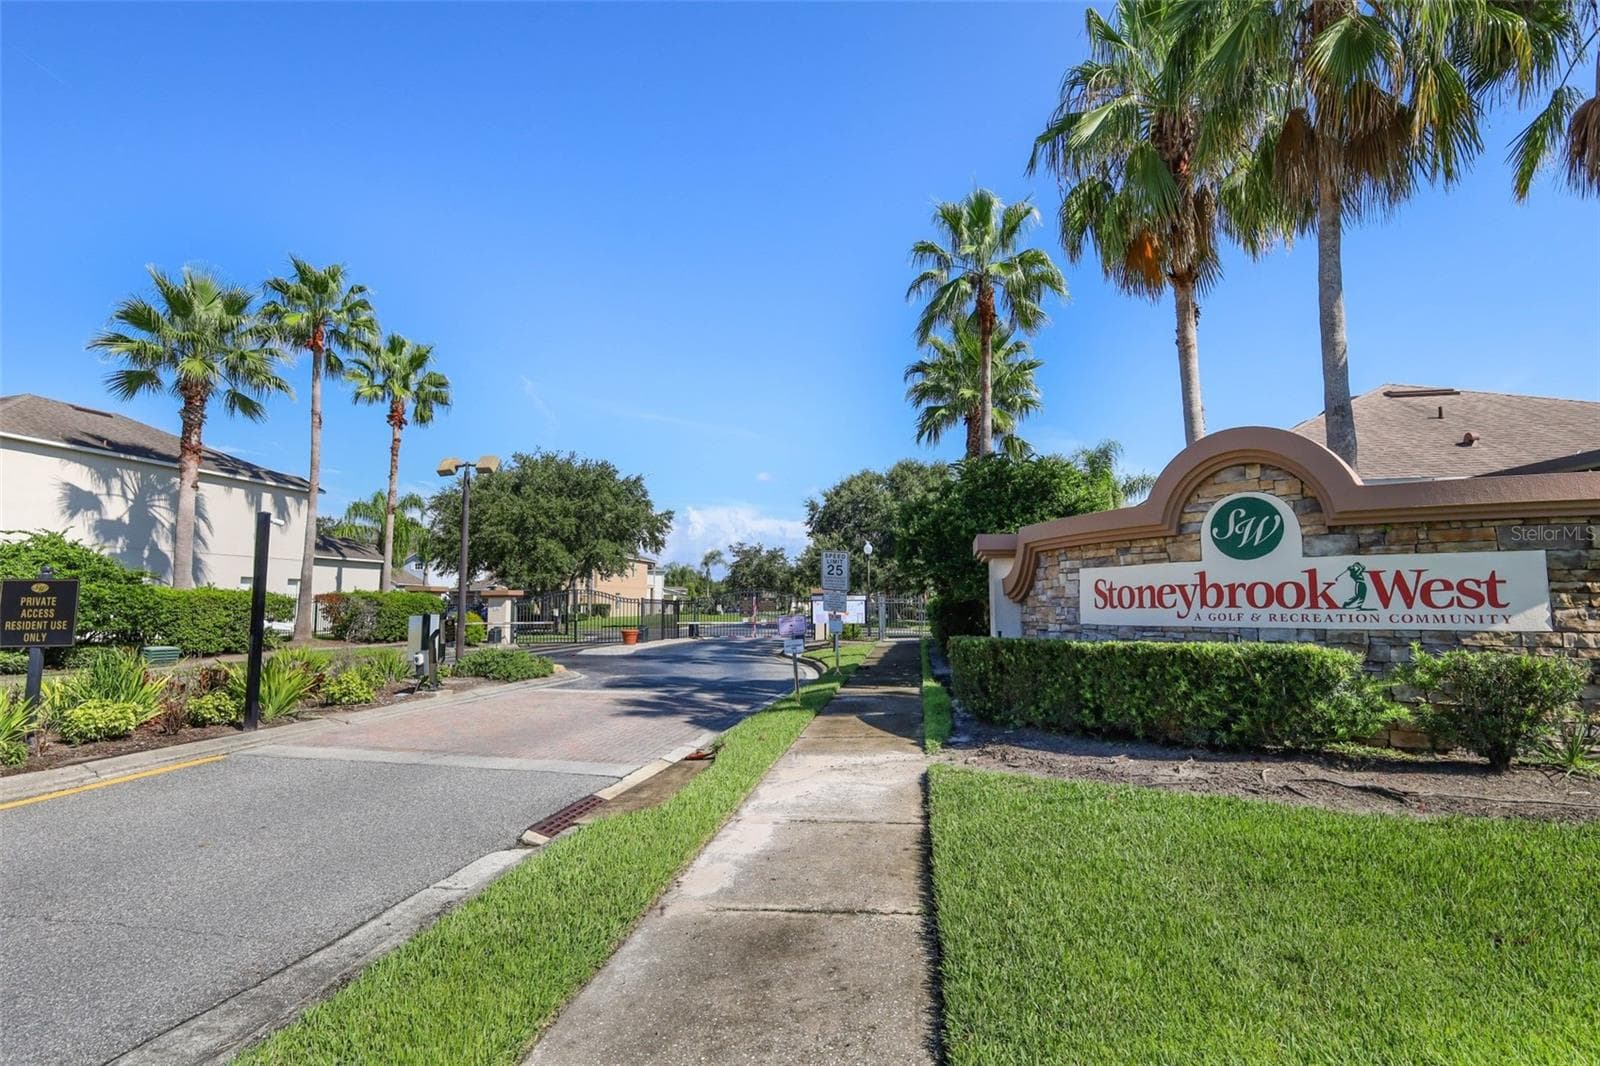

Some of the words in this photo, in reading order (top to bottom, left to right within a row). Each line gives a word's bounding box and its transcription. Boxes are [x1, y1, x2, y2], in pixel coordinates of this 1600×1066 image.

[827, 564, 844, 576] 25
[1093, 567, 1342, 619] Stoneybrook
[1364, 568, 1510, 610] West
[20, 596, 57, 606] PRIVATE
[20, 608, 56, 618] ACCESS
[1194, 612, 1202, 622] A
[1208, 613, 1245, 622] GOLF
[1250, 614, 1261, 622] &
[1268, 613, 1380, 623] RECREATION
[1389, 613, 1513, 624] COMMUNITY
[4, 620, 49, 631] RESIDENT
[50, 620, 68, 630] USE
[23, 632, 47, 642] ONLY
